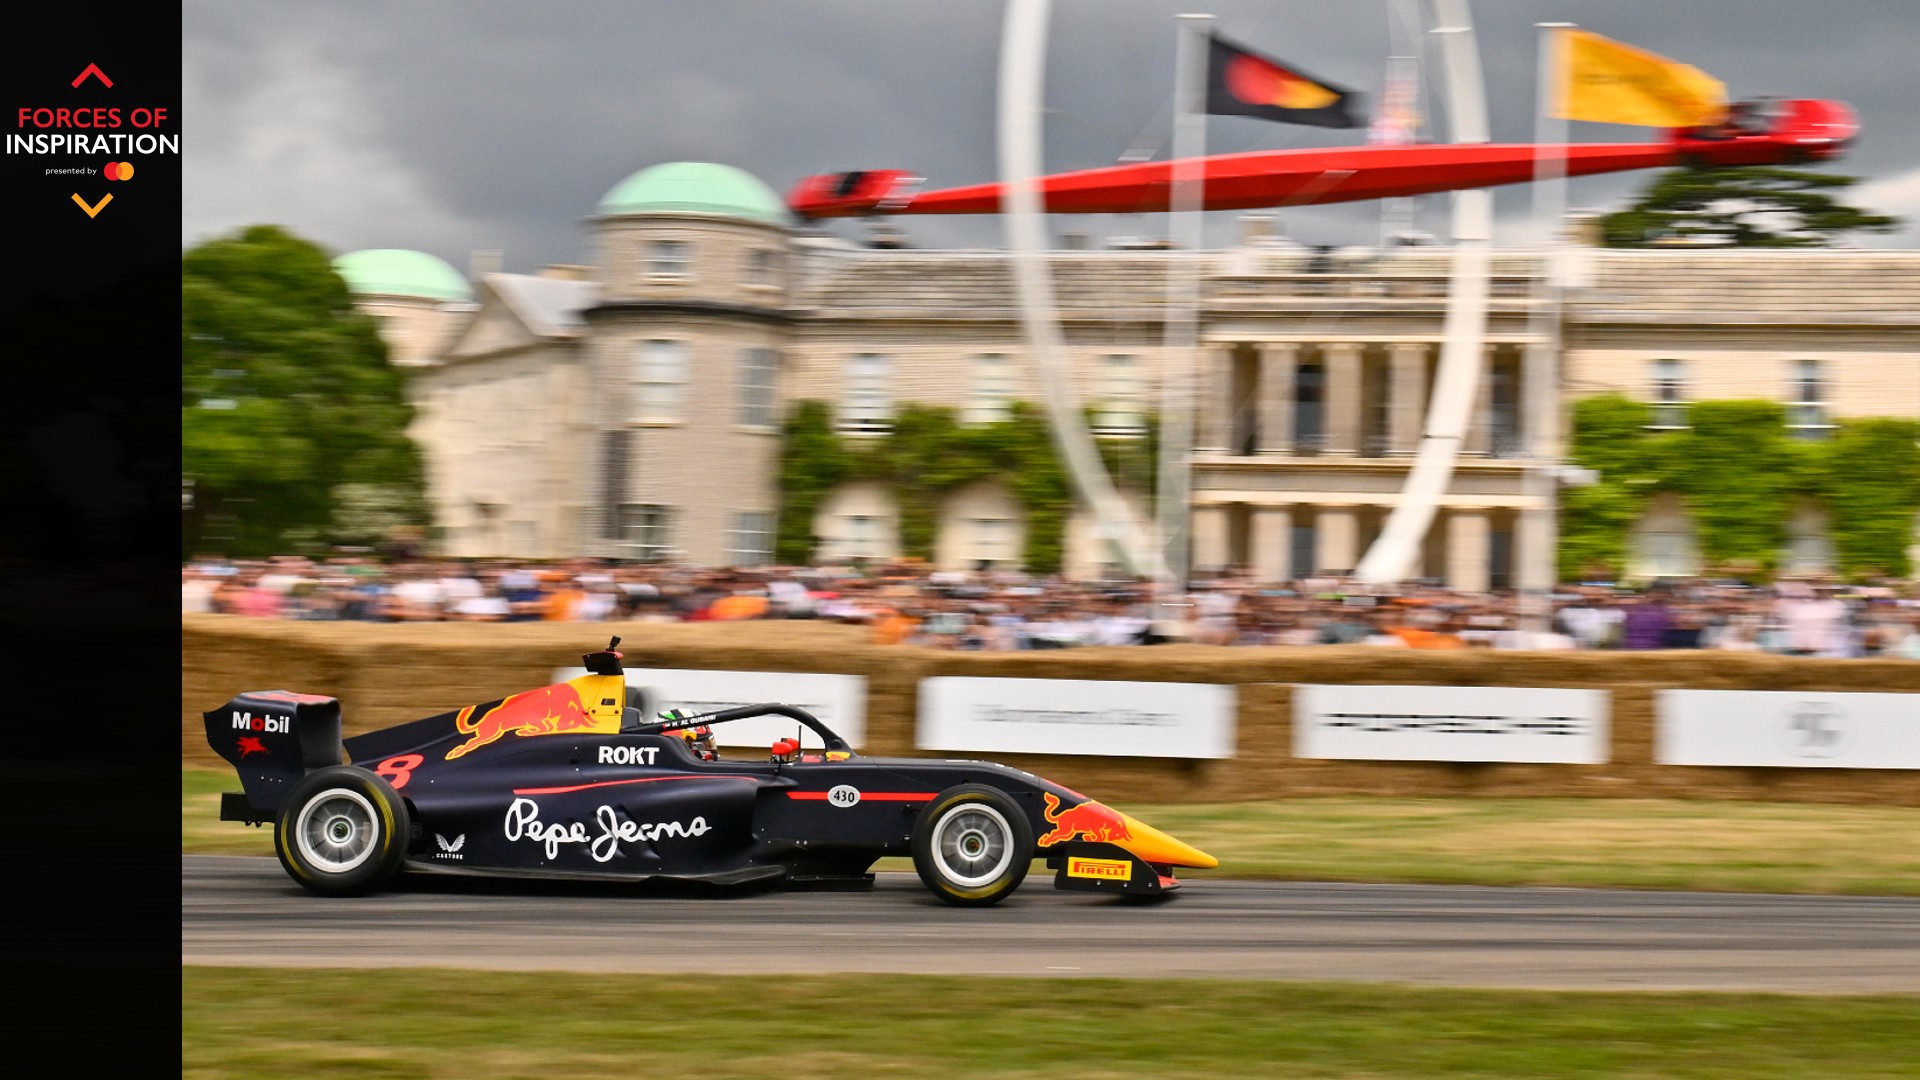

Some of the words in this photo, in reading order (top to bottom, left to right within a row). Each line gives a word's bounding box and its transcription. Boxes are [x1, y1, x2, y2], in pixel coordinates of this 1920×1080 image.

[232, 711, 290, 734] Mobil
[598, 745, 660, 765] ROKT
[374, 753, 425, 790] 8
[833, 790, 855, 803] 430
[504, 798, 591, 860] Pepe
[591, 805, 712, 863] Jeans
[1073, 861, 1126, 877] PIRELLI
